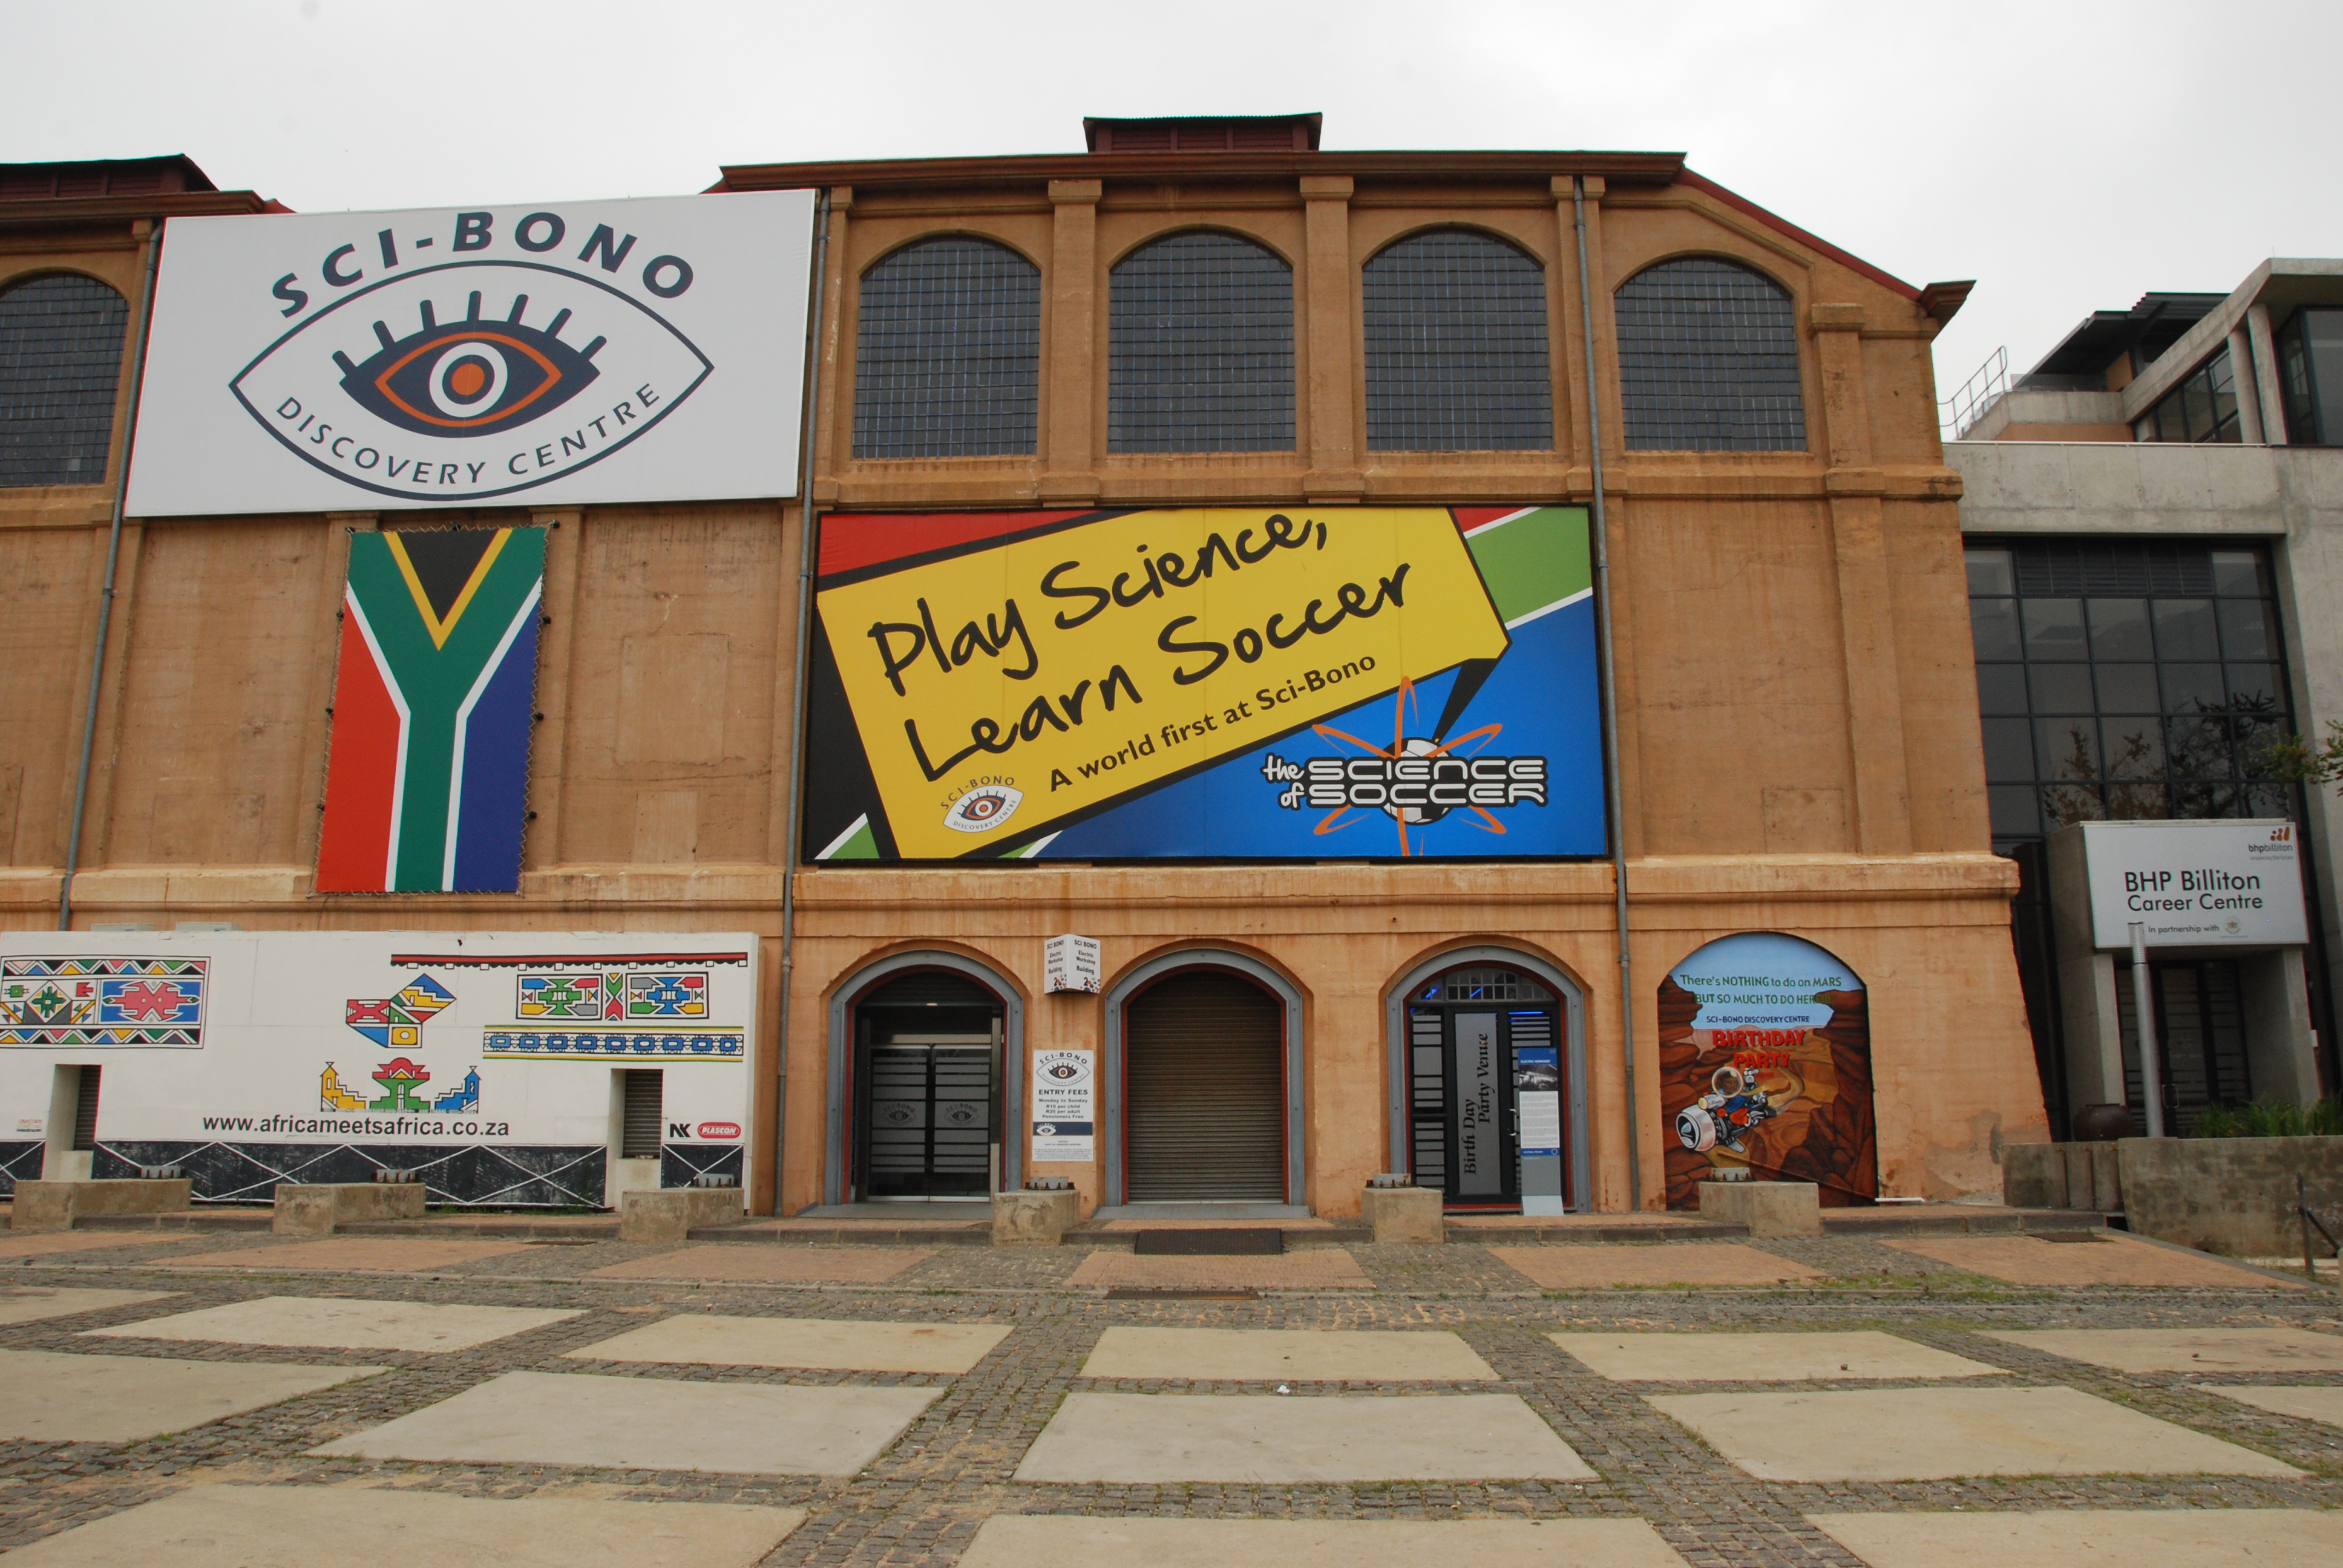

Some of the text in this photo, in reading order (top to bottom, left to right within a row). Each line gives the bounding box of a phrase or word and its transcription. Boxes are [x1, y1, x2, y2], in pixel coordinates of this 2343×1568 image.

[272, 211, 694, 319] SCI-BONO
[276, 383, 661, 485] DISCOVERY CENTRE
[867, 514, 1328, 697] Play Science,
[904, 563, 1411, 782] Learn Soccer
[1049, 655, 1376, 792] A world first at Sci-Bono
[1262, 754, 1545, 781] the SCIENCE
[941, 776, 1015, 809] SCI-BONO
[1280, 783, 1545, 809] of SOCCER
[954, 800, 1017, 830] DISCOVERY CENTRE
[2248, 843, 2293, 853] bhpbilliton
[2125, 869, 2261, 892] BHP Billiton
[2128, 893, 2263, 912] Career Centre
[2158, 925, 2201, 935] partnership
[1054, 939, 1064, 948] BONO
[1076, 956, 1096, 965] Workshop
[1078, 950, 1094, 958] Electric
[1076, 965, 1095, 975] Building
[1054, 977, 1058, 987] 2
[1084, 976, 1088, 987] 2
[1680, 975, 1720, 985] There's
[1722, 976, 1769, 987] NOTHING
[1771, 978, 1781, 987] to
[1784, 978, 1796, 987] do
[1813, 977, 1842, 987] MARS
[1696, 994, 1714, 1004] BUT
[1717, 994, 1731, 1004] SO
[1733, 995, 1763, 1004] MUCH
[1765, 995, 1778, 1004] TO
[1780, 995, 1795, 1004] DO
[1712, 1030, 1806, 1047] BIRTHDAY
[1040, 1052, 1087, 1064] SCI-BONO
[1734, 1053, 1791, 1068] PARTY
[1476, 1033, 1495, 1124] Party Venue
[203, 1115, 509, 1136] www.africameetsafrica.co.za
[1463, 1099, 1477, 1175] Birth Day
